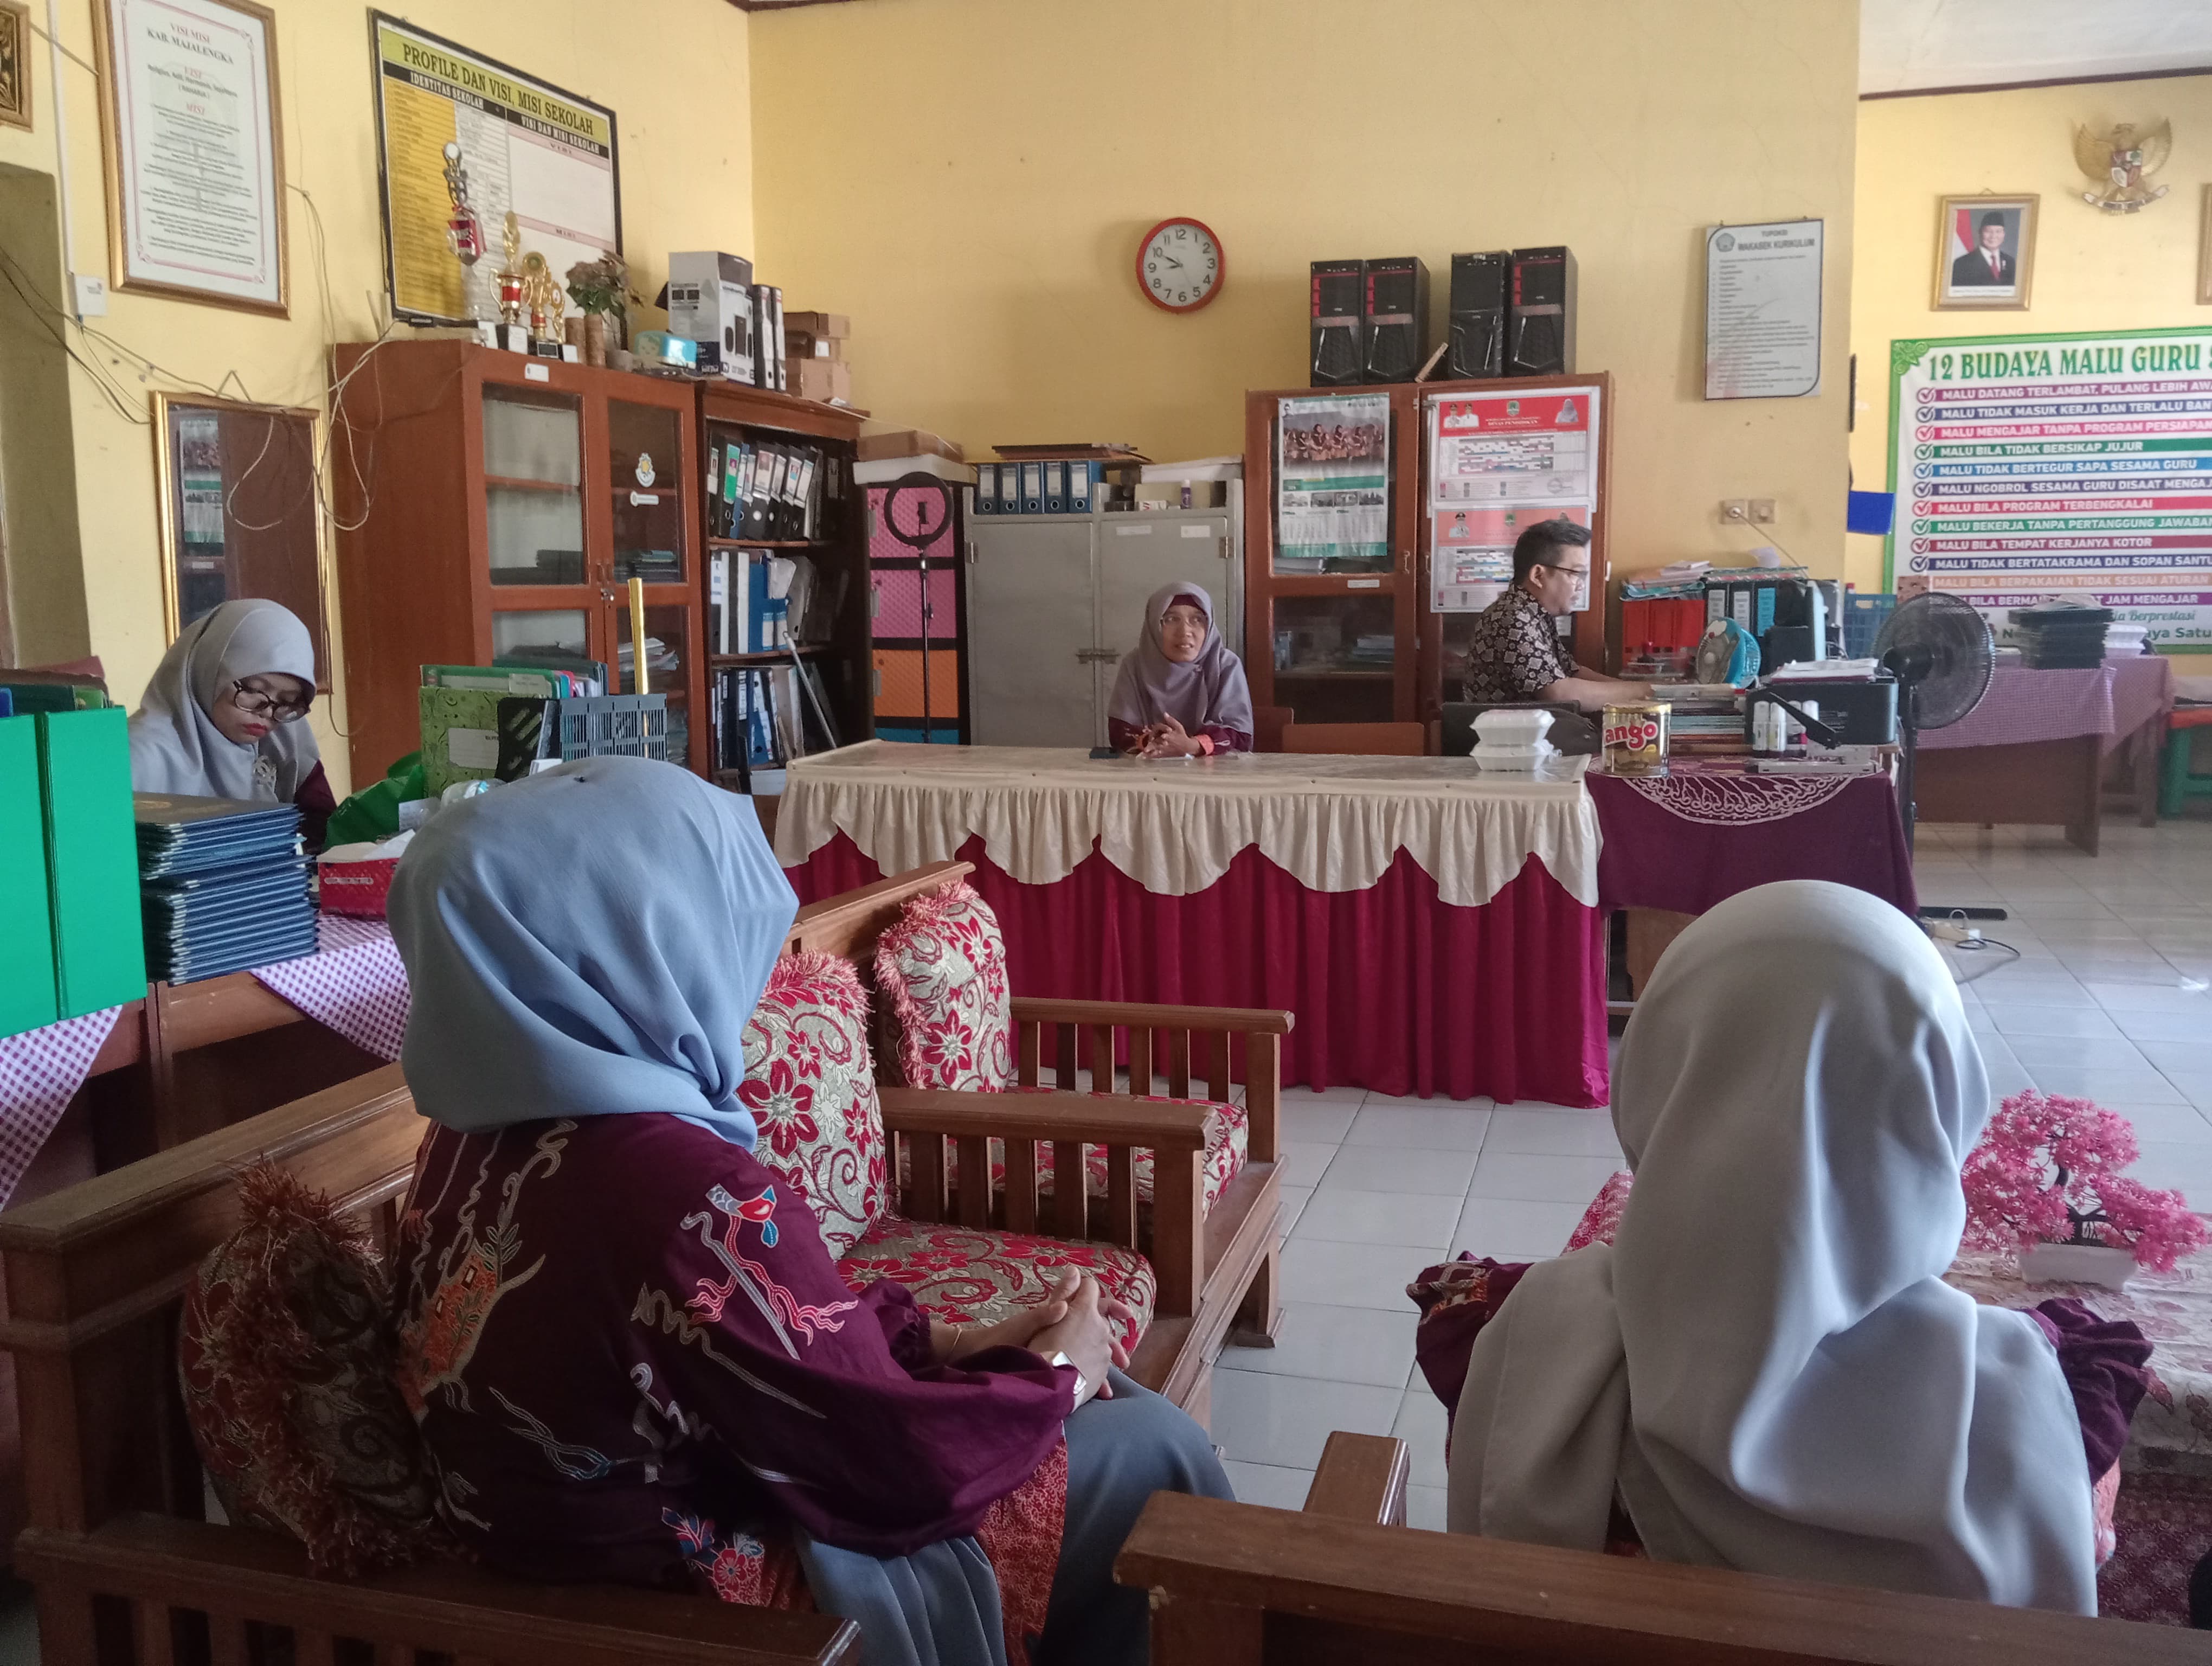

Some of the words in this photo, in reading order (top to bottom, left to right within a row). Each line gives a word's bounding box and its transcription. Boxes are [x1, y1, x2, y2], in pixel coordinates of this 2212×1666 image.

[170, 22, 188, 36] VISI
[190, 29, 210, 43] MISI
[172, 35, 234, 65] MAJALENGKA
[403, 43, 459, 81] PROFILE
[461, 66, 486, 92] DAN
[518, 90, 542, 116] MISI
[545, 102, 594, 136] SEKOLAH
[410, 71, 452, 97] IDENTITAS
[452, 86, 484, 110] SEKOLAH
[521, 116, 537, 130] VISI
[538, 123, 552, 136] DAN
[553, 127, 568, 143] MISI
[569, 134, 600, 155] SEKOLAH
[1163, 235, 1170, 245] 11
[1176, 229, 1186, 240] 12
[1194, 233, 1198, 243] 1
[1153, 247, 1162, 258] 10
[1203, 243, 1211, 254] 2
[1148, 263, 1156, 273] 9
[1207, 259, 1216, 270] 3
[1154, 279, 1161, 288] 8
[1203, 274, 1211, 284] 4
[1166, 289, 1172, 299] 7
[1178, 292, 1187, 302] 6
[1193, 287, 1201, 297] 5
[1930, 355, 1953, 380] 12
[1960, 351, 2053, 379] BUDAYA
[2060, 347, 2123, 375] MALU
[2131, 344, 2201, 372] GURU
[1943, 390, 1975, 399] MALU
[1978, 388, 2024, 398] DATANG
[2101, 383, 2150, 393] PULANG
[2153, 382, 2188, 392] LEBIH
[2191, 381, 2212, 390] AW
[1941, 409, 1975, 418] MALU
[1977, 407, 2012, 416] TIDAK
[2015, 406, 2057, 416] MASUK
[2059, 405, 2098, 414] KERJA
[2101, 403, 2126, 413] DAN
[2130, 402, 2182, 412] TERLALU
[2186, 401, 2212, 409] BAN
[1941, 428, 1975, 437] MALU
[1977, 426, 2040, 436] MENGAJAR
[2043, 424, 2081, 434] TANPA
[2084, 423, 2143, 433] PROGRAM
[1941, 447, 1973, 456] MALU
[1976, 446, 2002, 455] BILA
[2005, 445, 2040, 454] TIDAK
[2043, 443, 2102, 453] BERSIKAP
[2105, 442, 2143, 451] JUJUR
[1940, 466, 1972, 475] MALU
[1976, 465, 2009, 473] TIDAK
[2012, 463, 2073, 473] BERTEGUR
[2076, 463, 2108, 471] SAPA
[2111, 461, 2160, 470] SESAMA
[2164, 460, 2197, 469] GURU
[1939, 485, 1971, 494] MALU
[1974, 483, 2028, 493] NGOBROL
[2031, 482, 2080, 491] SESAMA
[2083, 482, 2115, 490] GURU
[2118, 480, 2162, 489] DISAAT
[2164, 479, 2212, 488] MENGAJ
[1938, 503, 1970, 512] MALU
[1973, 503, 2000, 511] BILA
[2003, 502, 2060, 511] PROGRAM
[2062, 499, 2153, 510] TERBENGKALAI
[1938, 522, 1970, 531] MALU
[1973, 521, 2024, 530] BEKERJA
[2027, 520, 2065, 529] TANPA
[2068, 519, 2155, 528] PERTANGGUNG
[1937, 541, 1969, 550] MALU
[1972, 540, 1998, 549] BILA
[2002, 540, 2046, 548] TEMPAT
[2049, 539, 2110, 548] KERJANYA
[2113, 537, 2152, 547] KOTOR
[1935, 560, 1969, 568] MALU
[1971, 559, 2005, 567] TIDAK
[2008, 558, 2101, 567] BERTATAKRAMA
[2105, 557, 2130, 566] DAN
[2132, 556, 2172, 565] SOPAN
[2175, 556, 2212, 565] SANTU
[1934, 578, 1967, 587] MALU
[1969, 578, 1996, 586] BILA
[1999, 576, 2073, 586] BERPAKAIAN
[2078, 576, 2111, 585] TIDAK
[2115, 576, 2156, 585] SESUAI
[2161, 575, 2208, 584] ATURAN
[1969, 597, 1996, 605] BILA
[2106, 595, 2131, 604] JAM
[2133, 594, 2198, 603] MENGAJAR
[2129, 610, 2195, 623] Berprestasi
[1604, 723, 1657, 749] ango
